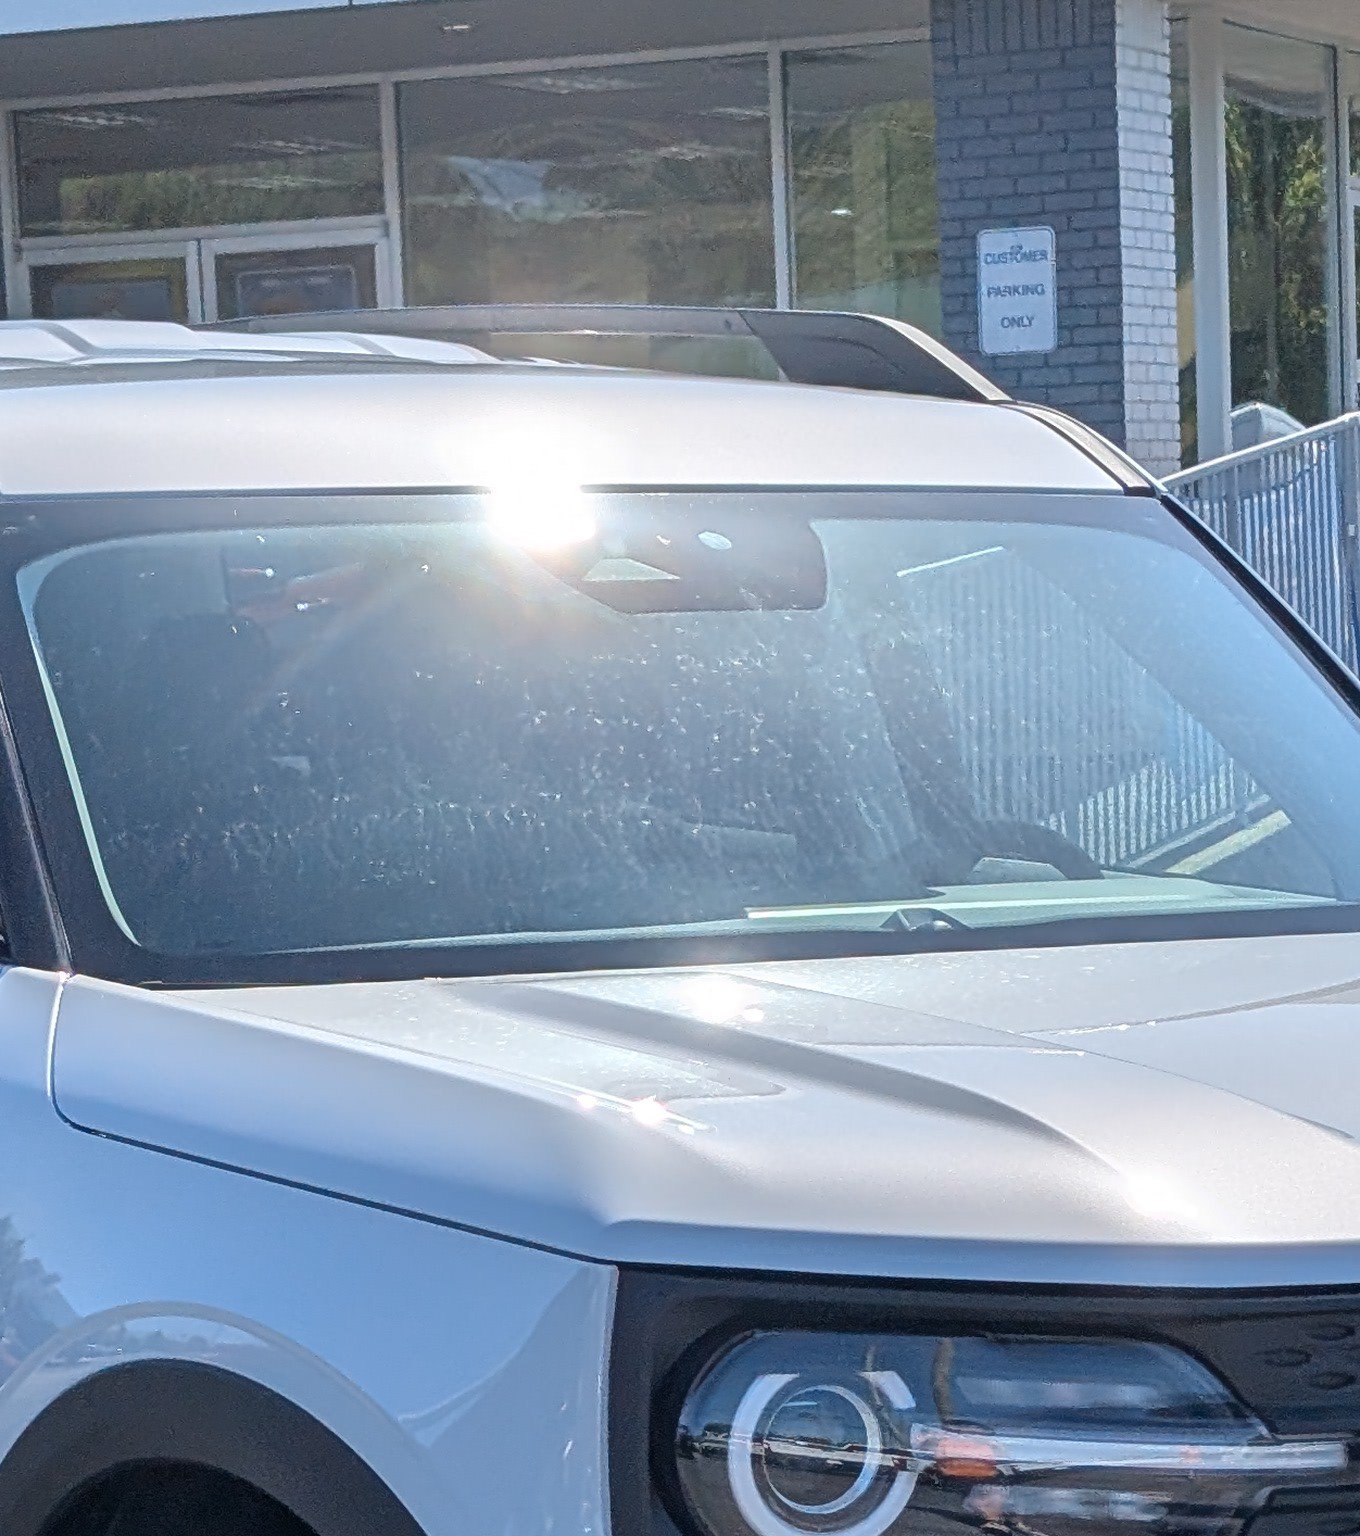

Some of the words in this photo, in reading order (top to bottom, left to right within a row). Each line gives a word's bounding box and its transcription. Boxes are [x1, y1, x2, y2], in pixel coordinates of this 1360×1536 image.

[983, 249, 1048, 265] CUSTOMER
[986, 283, 1046, 298] PARKING
[1000, 315, 1035, 329] ONLY
